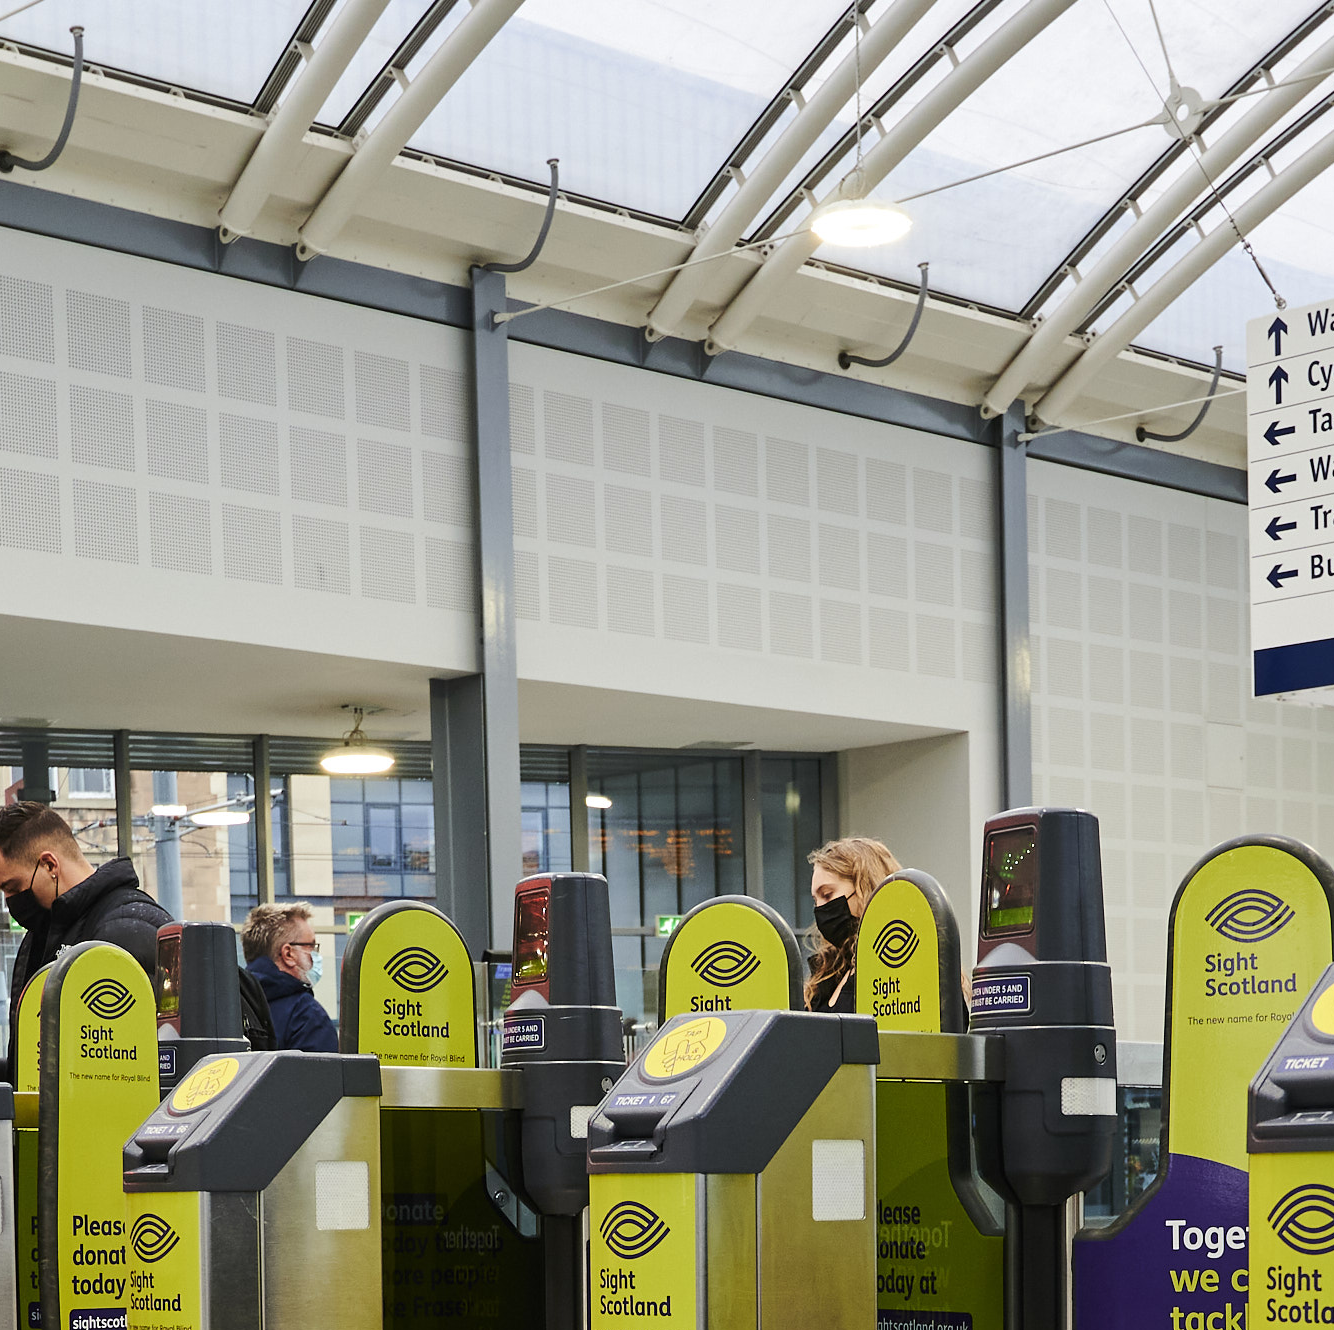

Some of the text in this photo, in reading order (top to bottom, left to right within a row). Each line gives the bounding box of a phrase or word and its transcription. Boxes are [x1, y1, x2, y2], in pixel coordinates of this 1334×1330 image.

[1204, 952, 1258, 979] Sight
[872, 976, 901, 998] Sight
[1007, 983, 1023, 993] AND
[1205, 973, 1297, 997] Scotland
[383, 998, 423, 1020] Sight
[690, 995, 732, 1012] Sight
[872, 995, 921, 1018] Scotland
[993, 994, 1025, 1005] CARRIED
[383, 1019, 450, 1039] Scotland
[1188, 1013, 1269, 1026] The new name for
[80, 1024, 114, 1044] Sight
[80, 1044, 137, 1061] Scotland
[399, 1053, 465, 1064] name Royal Blind
[1284, 1057, 1328, 1070] TICKET
[614, 1095, 676, 1106] TICKET 67
[72, 1243, 127, 1266] donat
[71, 1272, 127, 1300] today
[130, 1270, 154, 1293] Sight
[599, 1267, 636, 1295] Sight
[920, 1271, 938, 1295] at
[1169, 1268, 1220, 1293] we
[1266, 1265, 1323, 1298] Sight
[130, 1293, 182, 1312] Scotland
[600, 1295, 672, 1317] Scotland
